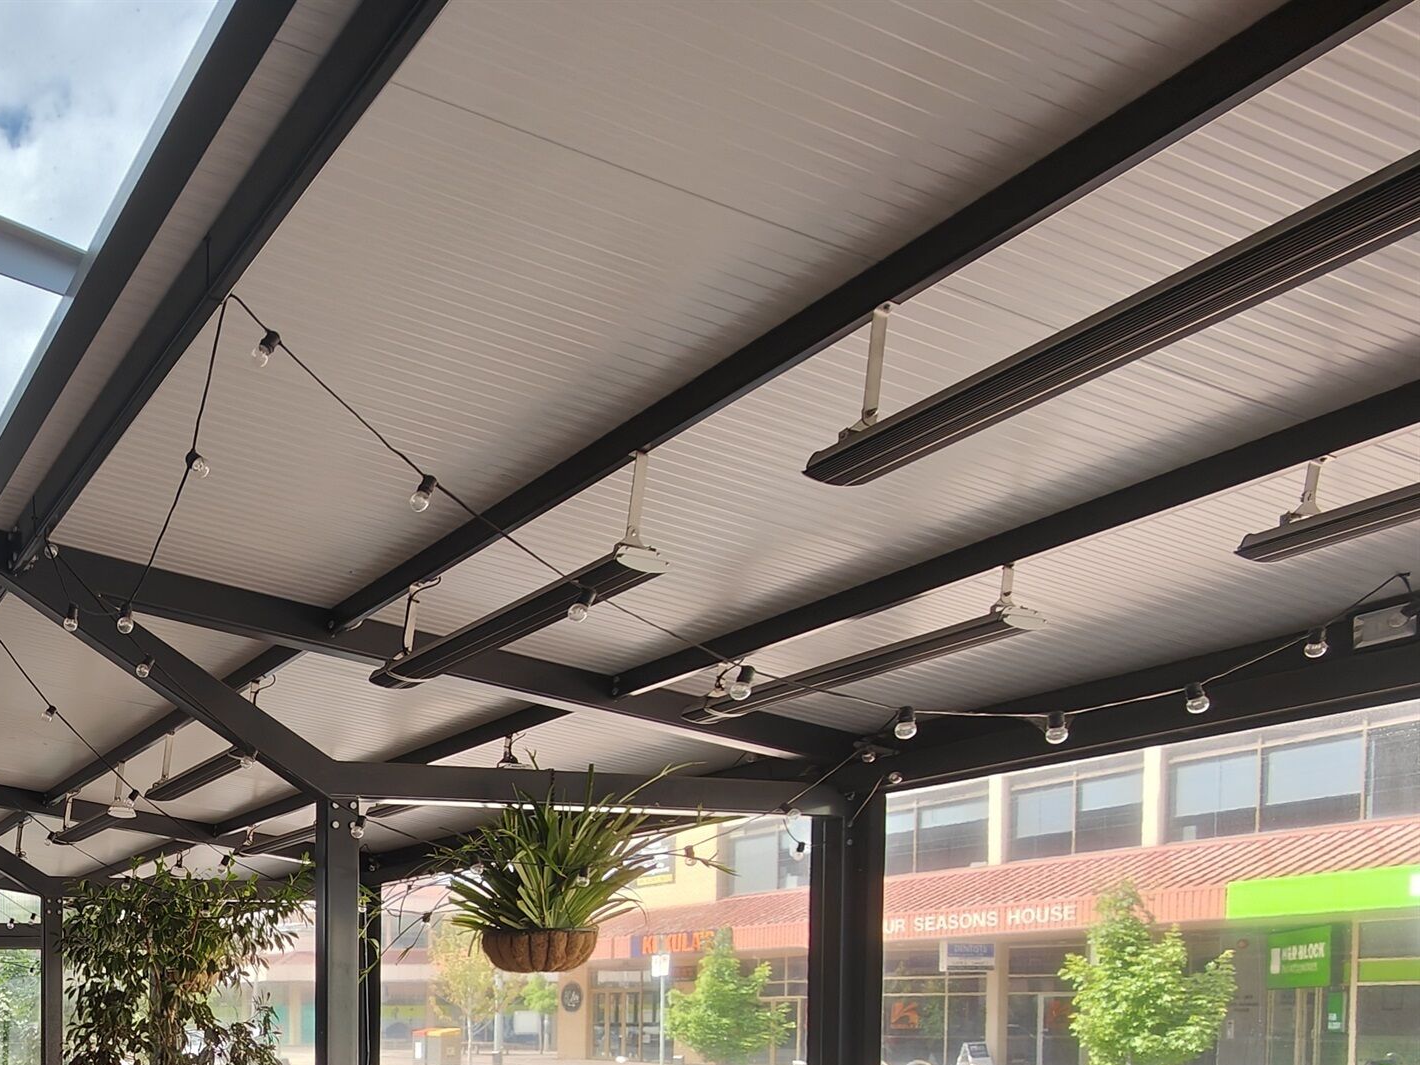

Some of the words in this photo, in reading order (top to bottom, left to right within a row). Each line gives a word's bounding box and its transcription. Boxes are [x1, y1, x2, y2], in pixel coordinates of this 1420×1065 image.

[884, 919, 906, 934] UR
[913, 910, 998, 932] SEASONS
[1007, 904, 1077, 925] HOUSE
